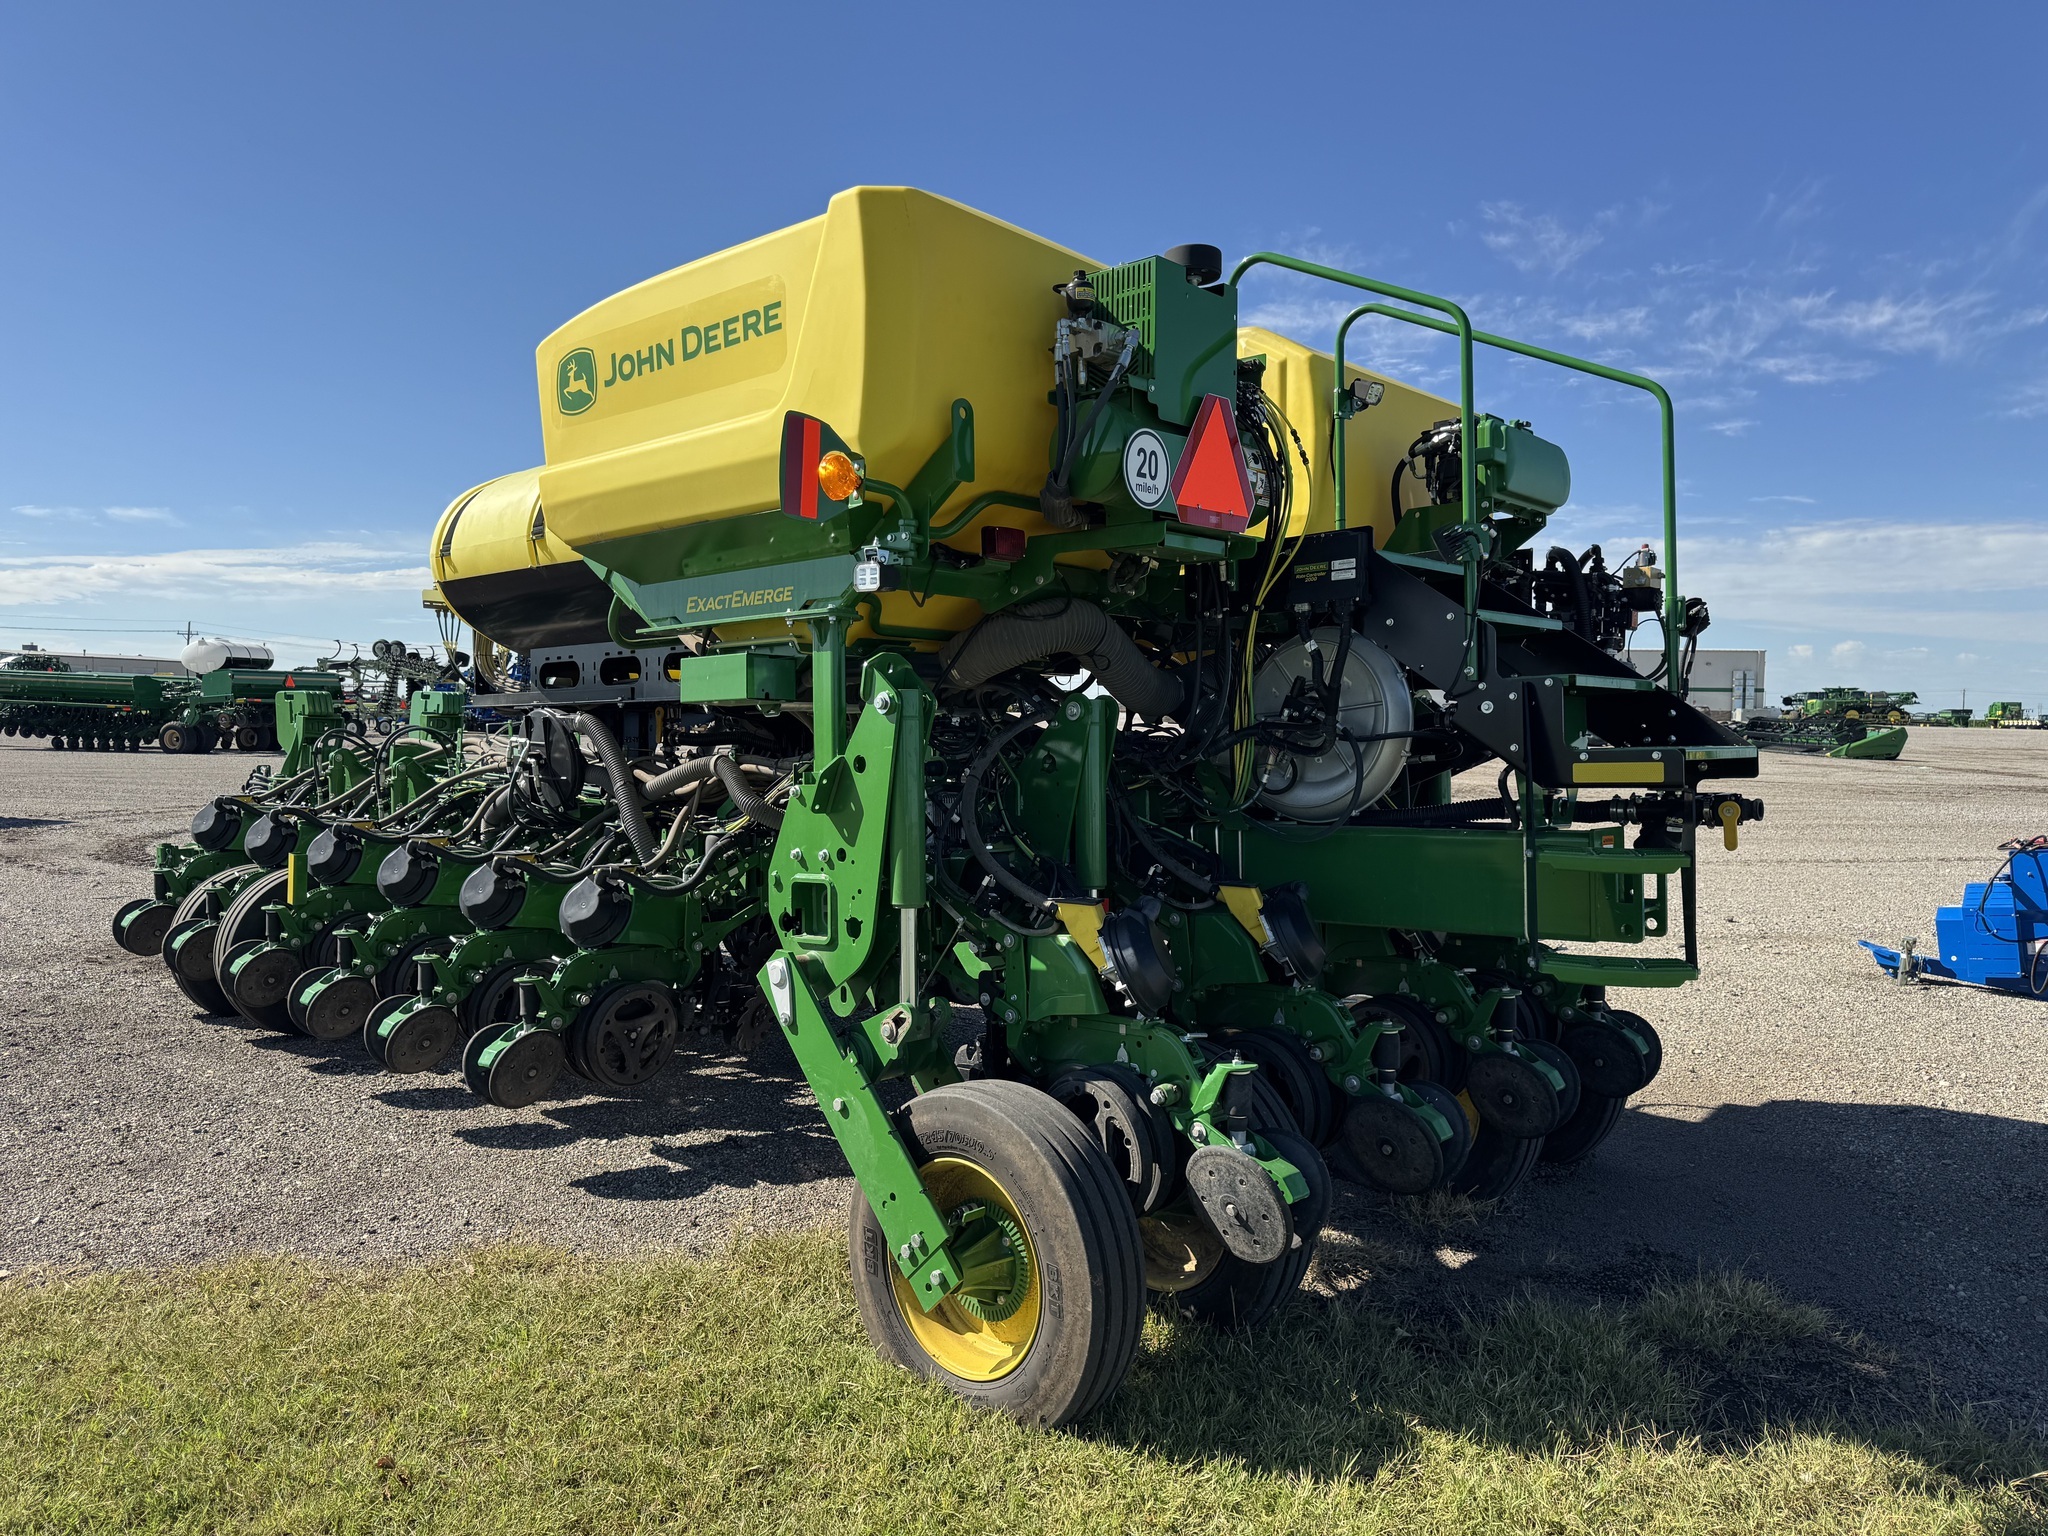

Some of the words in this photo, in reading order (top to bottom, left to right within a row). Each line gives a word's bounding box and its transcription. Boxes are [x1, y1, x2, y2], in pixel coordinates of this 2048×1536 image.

[604, 338, 675, 388] JOHN
[681, 300, 783, 362] DEERE
[1135, 481, 1159, 496] mile/h
[1136, 447, 1159, 481] 20
[863, 1226, 878, 1276] BKT
[1047, 1264, 1064, 1321] BKT
